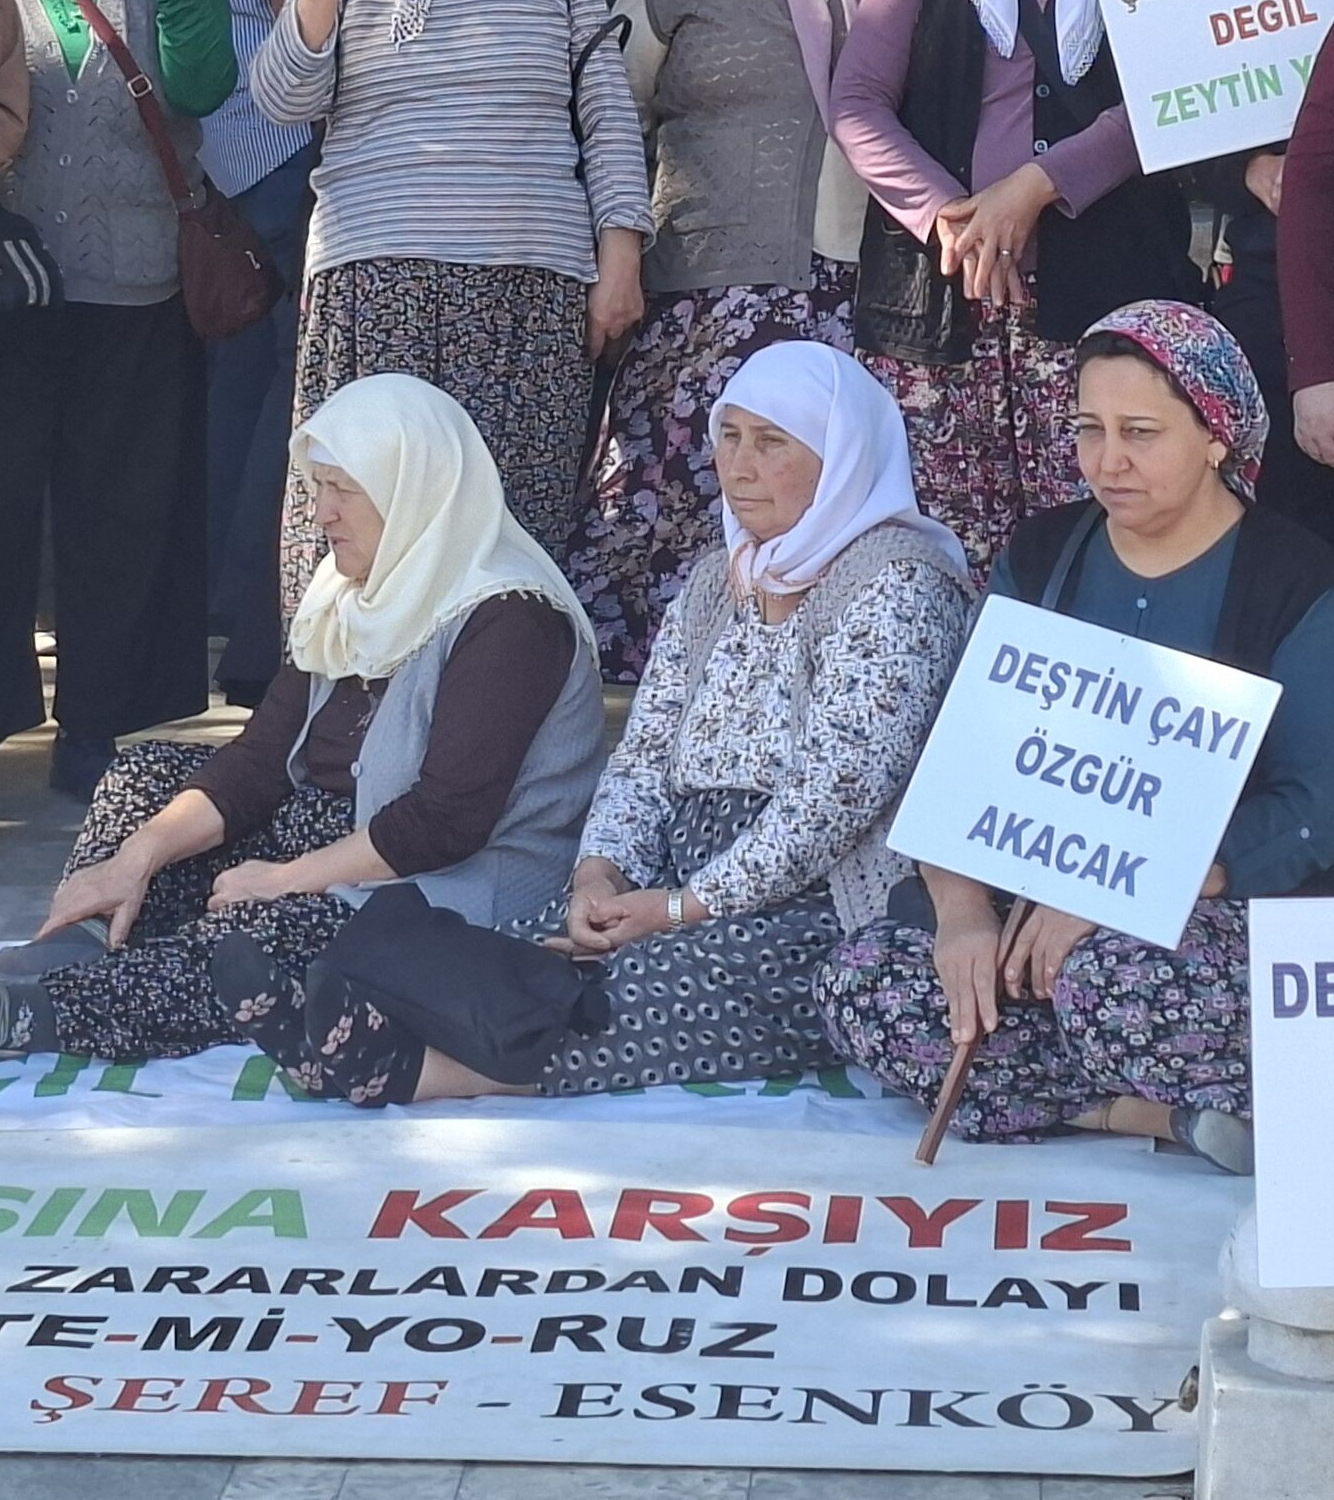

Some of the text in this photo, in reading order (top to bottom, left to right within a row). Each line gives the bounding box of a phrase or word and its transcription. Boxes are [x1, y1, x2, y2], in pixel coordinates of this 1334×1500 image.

[1151, 62, 1283, 127] ZEYTİN
[988, 643, 1251, 760] DEŞTİN ÇAYI
[1015, 726, 1162, 817] ÖZGÜR
[967, 805, 1148, 897] AKACAK
[368, 1188, 1132, 1256] KARŞIYIZ
[5, 1265, 744, 1298] ZARARLARDAN
[783, 1267, 1140, 1311] DOLAYI
[30, 1375, 449, 1424] ŞEREF
[539, 1383, 1182, 1433] ESENKÖY
